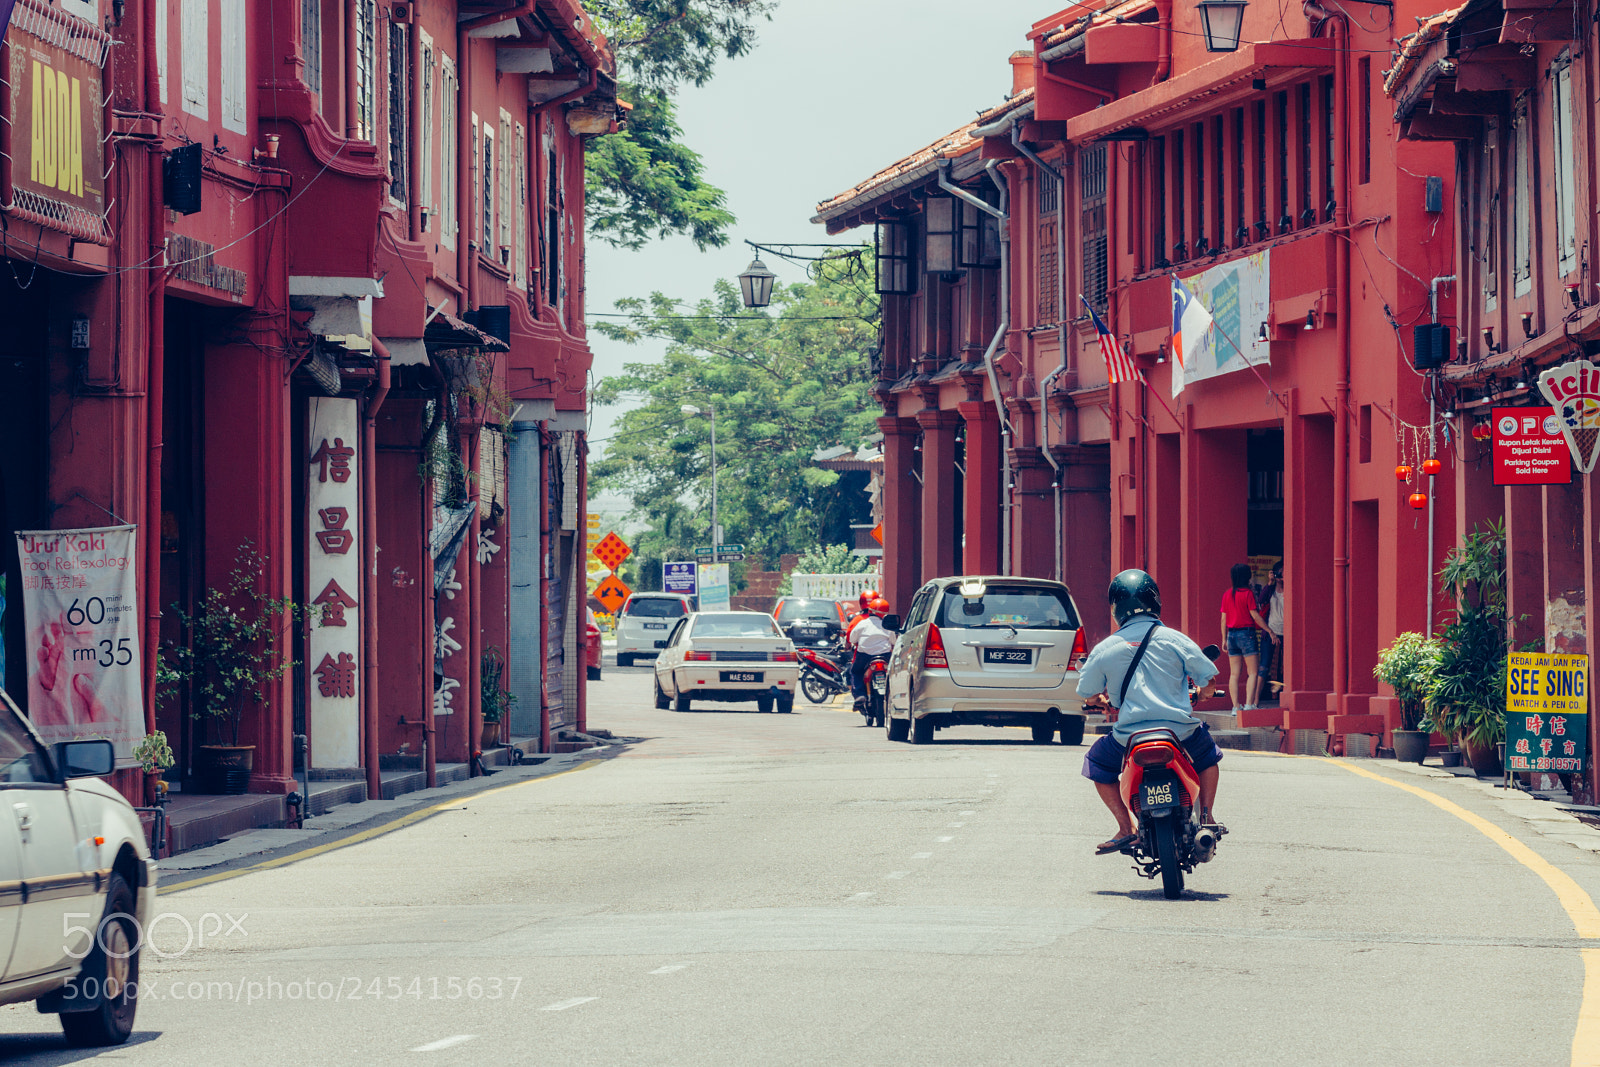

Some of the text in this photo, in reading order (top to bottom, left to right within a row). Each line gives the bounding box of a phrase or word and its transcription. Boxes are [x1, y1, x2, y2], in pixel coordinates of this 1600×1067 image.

[31, 60, 84, 198] ADDA
[1498, 439, 1521, 447] Kupon
[1512, 447, 1531, 455] Dijual
[1504, 459, 1530, 467] Parking
[24, 533, 105, 553] Urut Kaki
[23, 554, 131, 571] Foot Reflexology
[67, 597, 105, 626] 60
[106, 605, 132, 613] minutes
[989, 652, 1027, 661] MBF 3222
[1511, 657, 1586, 668] KEDAI JAM DAN PEN
[1510, 668, 1584, 697] SEE SING
[1513, 699, 1581, 709] WATCH & PEN CO.
[1510, 756, 1582, 770] TEL:2819571
[1147, 784, 1170, 796] MAG
[1147, 793, 1172, 805] 6166
